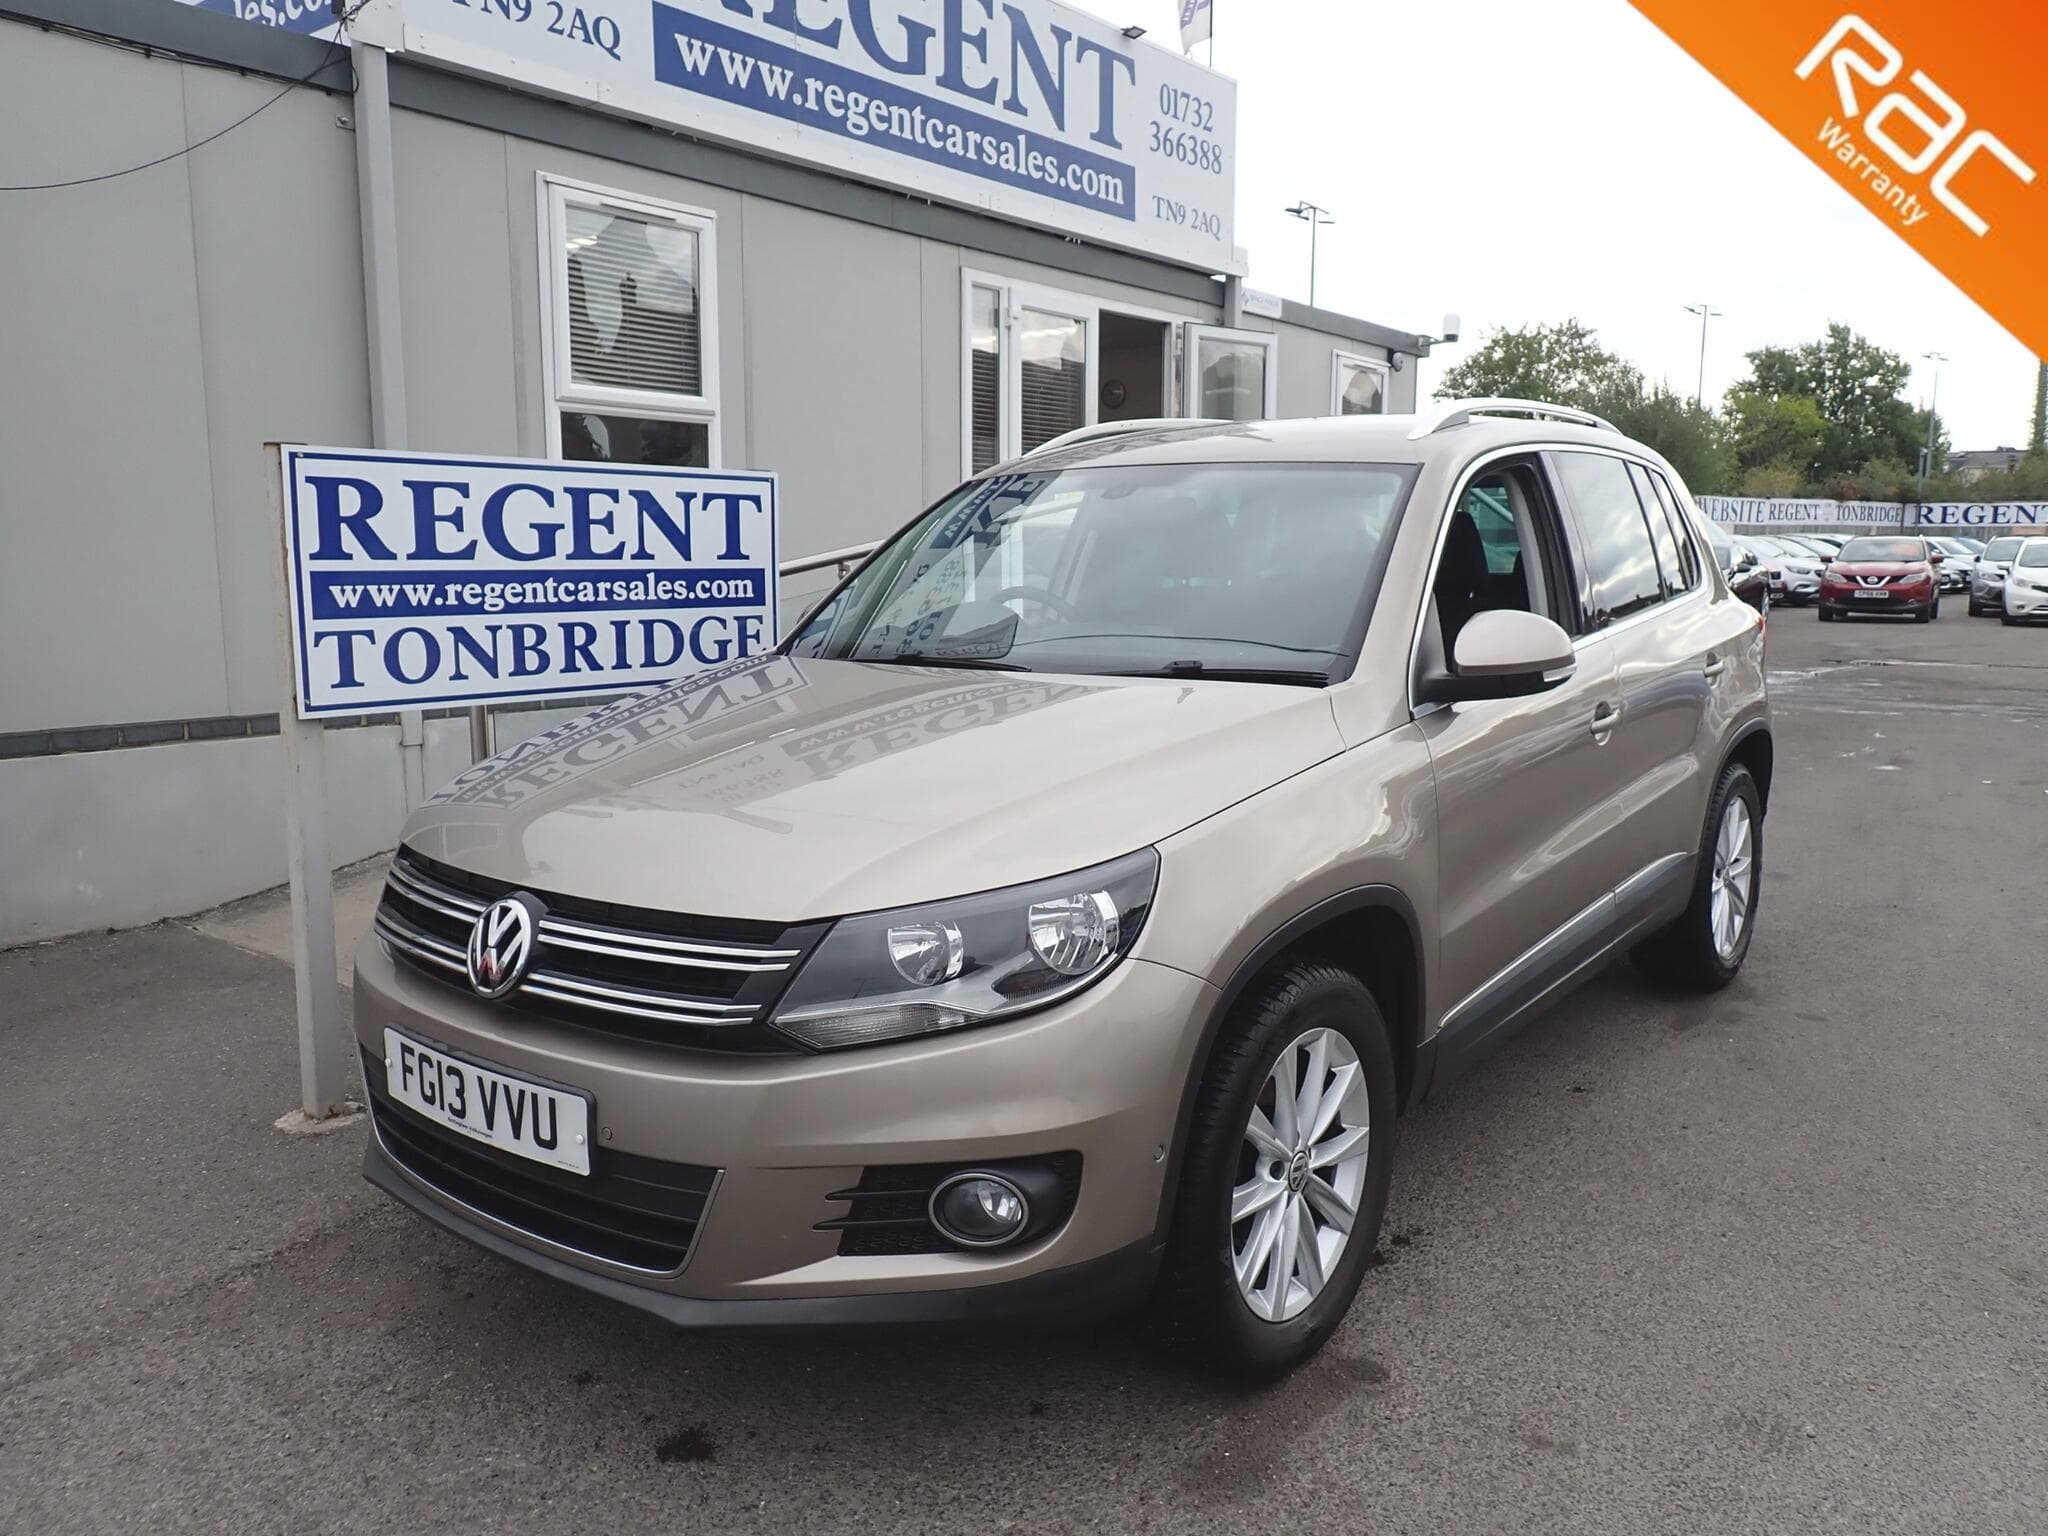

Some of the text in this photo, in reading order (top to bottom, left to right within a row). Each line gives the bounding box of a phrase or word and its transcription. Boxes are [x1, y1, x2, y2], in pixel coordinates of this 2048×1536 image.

[673, 32, 1125, 205] www.regentcarsales.com
[1159, 83, 1214, 133] 01732
[1150, 120, 1222, 175] 366388
[1152, 195, 1222, 241] TN9 2AQ
[304, 475, 763, 562] REGENT
[1768, 501, 1821, 522] REGENT
[1835, 502, 1903, 523] TONBRIDGE
[329, 571, 754, 612] www.regentcarsales.com
[313, 614, 765, 689] TONBRIDGE
[399, 1042, 558, 1151] FG13 VVU
